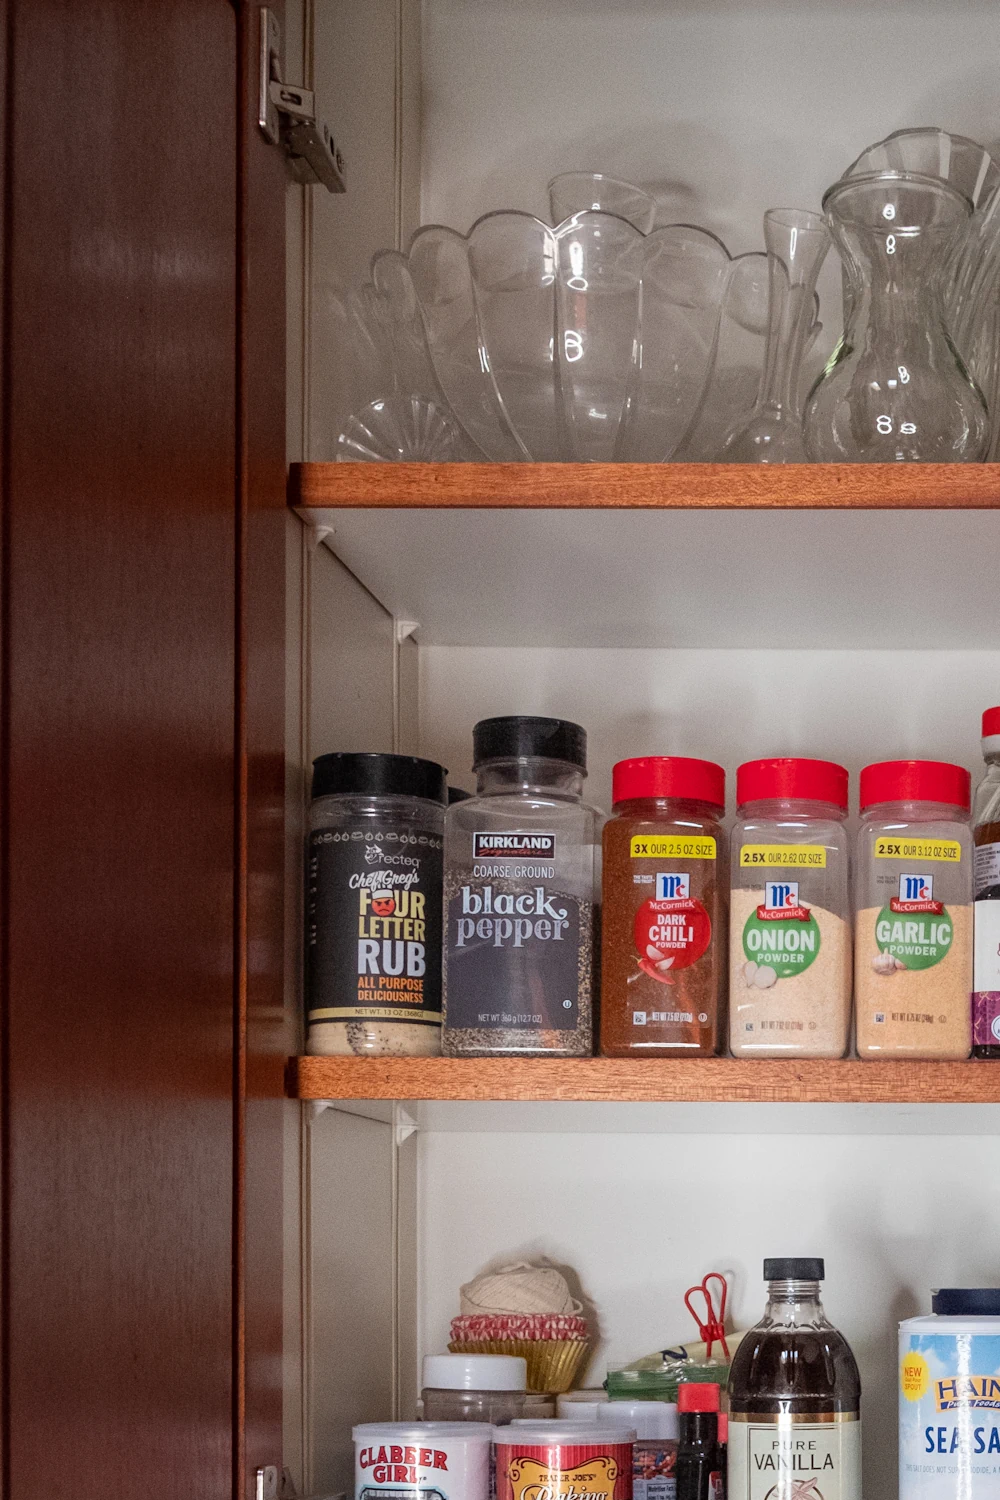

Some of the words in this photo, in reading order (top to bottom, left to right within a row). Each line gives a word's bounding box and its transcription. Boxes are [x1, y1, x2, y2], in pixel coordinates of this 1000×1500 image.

[479, 836, 551, 849] KIRKLAND
[634, 844, 648, 854] 3X
[651, 844, 667, 854] OUR
[669, 845, 682, 854] 2.5
[684, 845, 694, 855] OZ
[695, 845, 713, 856] SIZE
[878, 844, 901, 855] 2.5X
[903, 845, 917, 855] OUR
[917, 846, 932, 857] 3.12
[933, 847, 942, 857] OZ
[943, 847, 957, 858] SIZE
[743, 853, 766, 863] 2.5X
[768, 853, 782, 863] OUR
[782, 853, 798, 863] 2.62
[798, 854, 807, 863] OZ
[808, 854, 823, 864] SIZE
[473, 865, 511, 878] COARSE
[514, 866, 555, 879] GROUND
[349, 872, 380, 891] Chef
[382, 869, 420, 890] Greg's
[460, 886, 568, 920] black
[648, 900, 695, 910] McCormick
[892, 900, 938, 912] McCormick
[657, 914, 686, 926] DARK
[759, 908, 806, 919] McCormick
[359, 916, 426, 942] LETTER
[455, 917, 570, 948] pepper
[649, 926, 694, 942] CHILI
[876, 920, 951, 945] GARLIC
[656, 941, 687, 949] POWDER
[746, 929, 815, 952] ONION
[889, 944, 937, 957] POWDER
[358, 939, 426, 977] RUB
[757, 953, 804, 963] POWDER
[358, 977, 376, 989] ALL
[379, 977, 424, 992] PURPOSE
[358, 990, 424, 1004] DELICIOUSNESS
[393, 1009, 403, 1017] OZ
[478, 1014, 490, 1022] NET
[905, 1367, 922, 1377] NEW
[974, 1399, 1000, 1407] Foods
[772, 1441, 817, 1450] PURE
[925, 1426, 961, 1454] SEA
[360, 1445, 448, 1471] CLABBER
[754, 1453, 834, 1471] VANILLA
[373, 1465, 418, 1483] GIRL
[922, 1465, 935, 1473] DOES
[539, 1474, 569, 1482] TRADER
[572, 1473, 594, 1481] JOE'S
